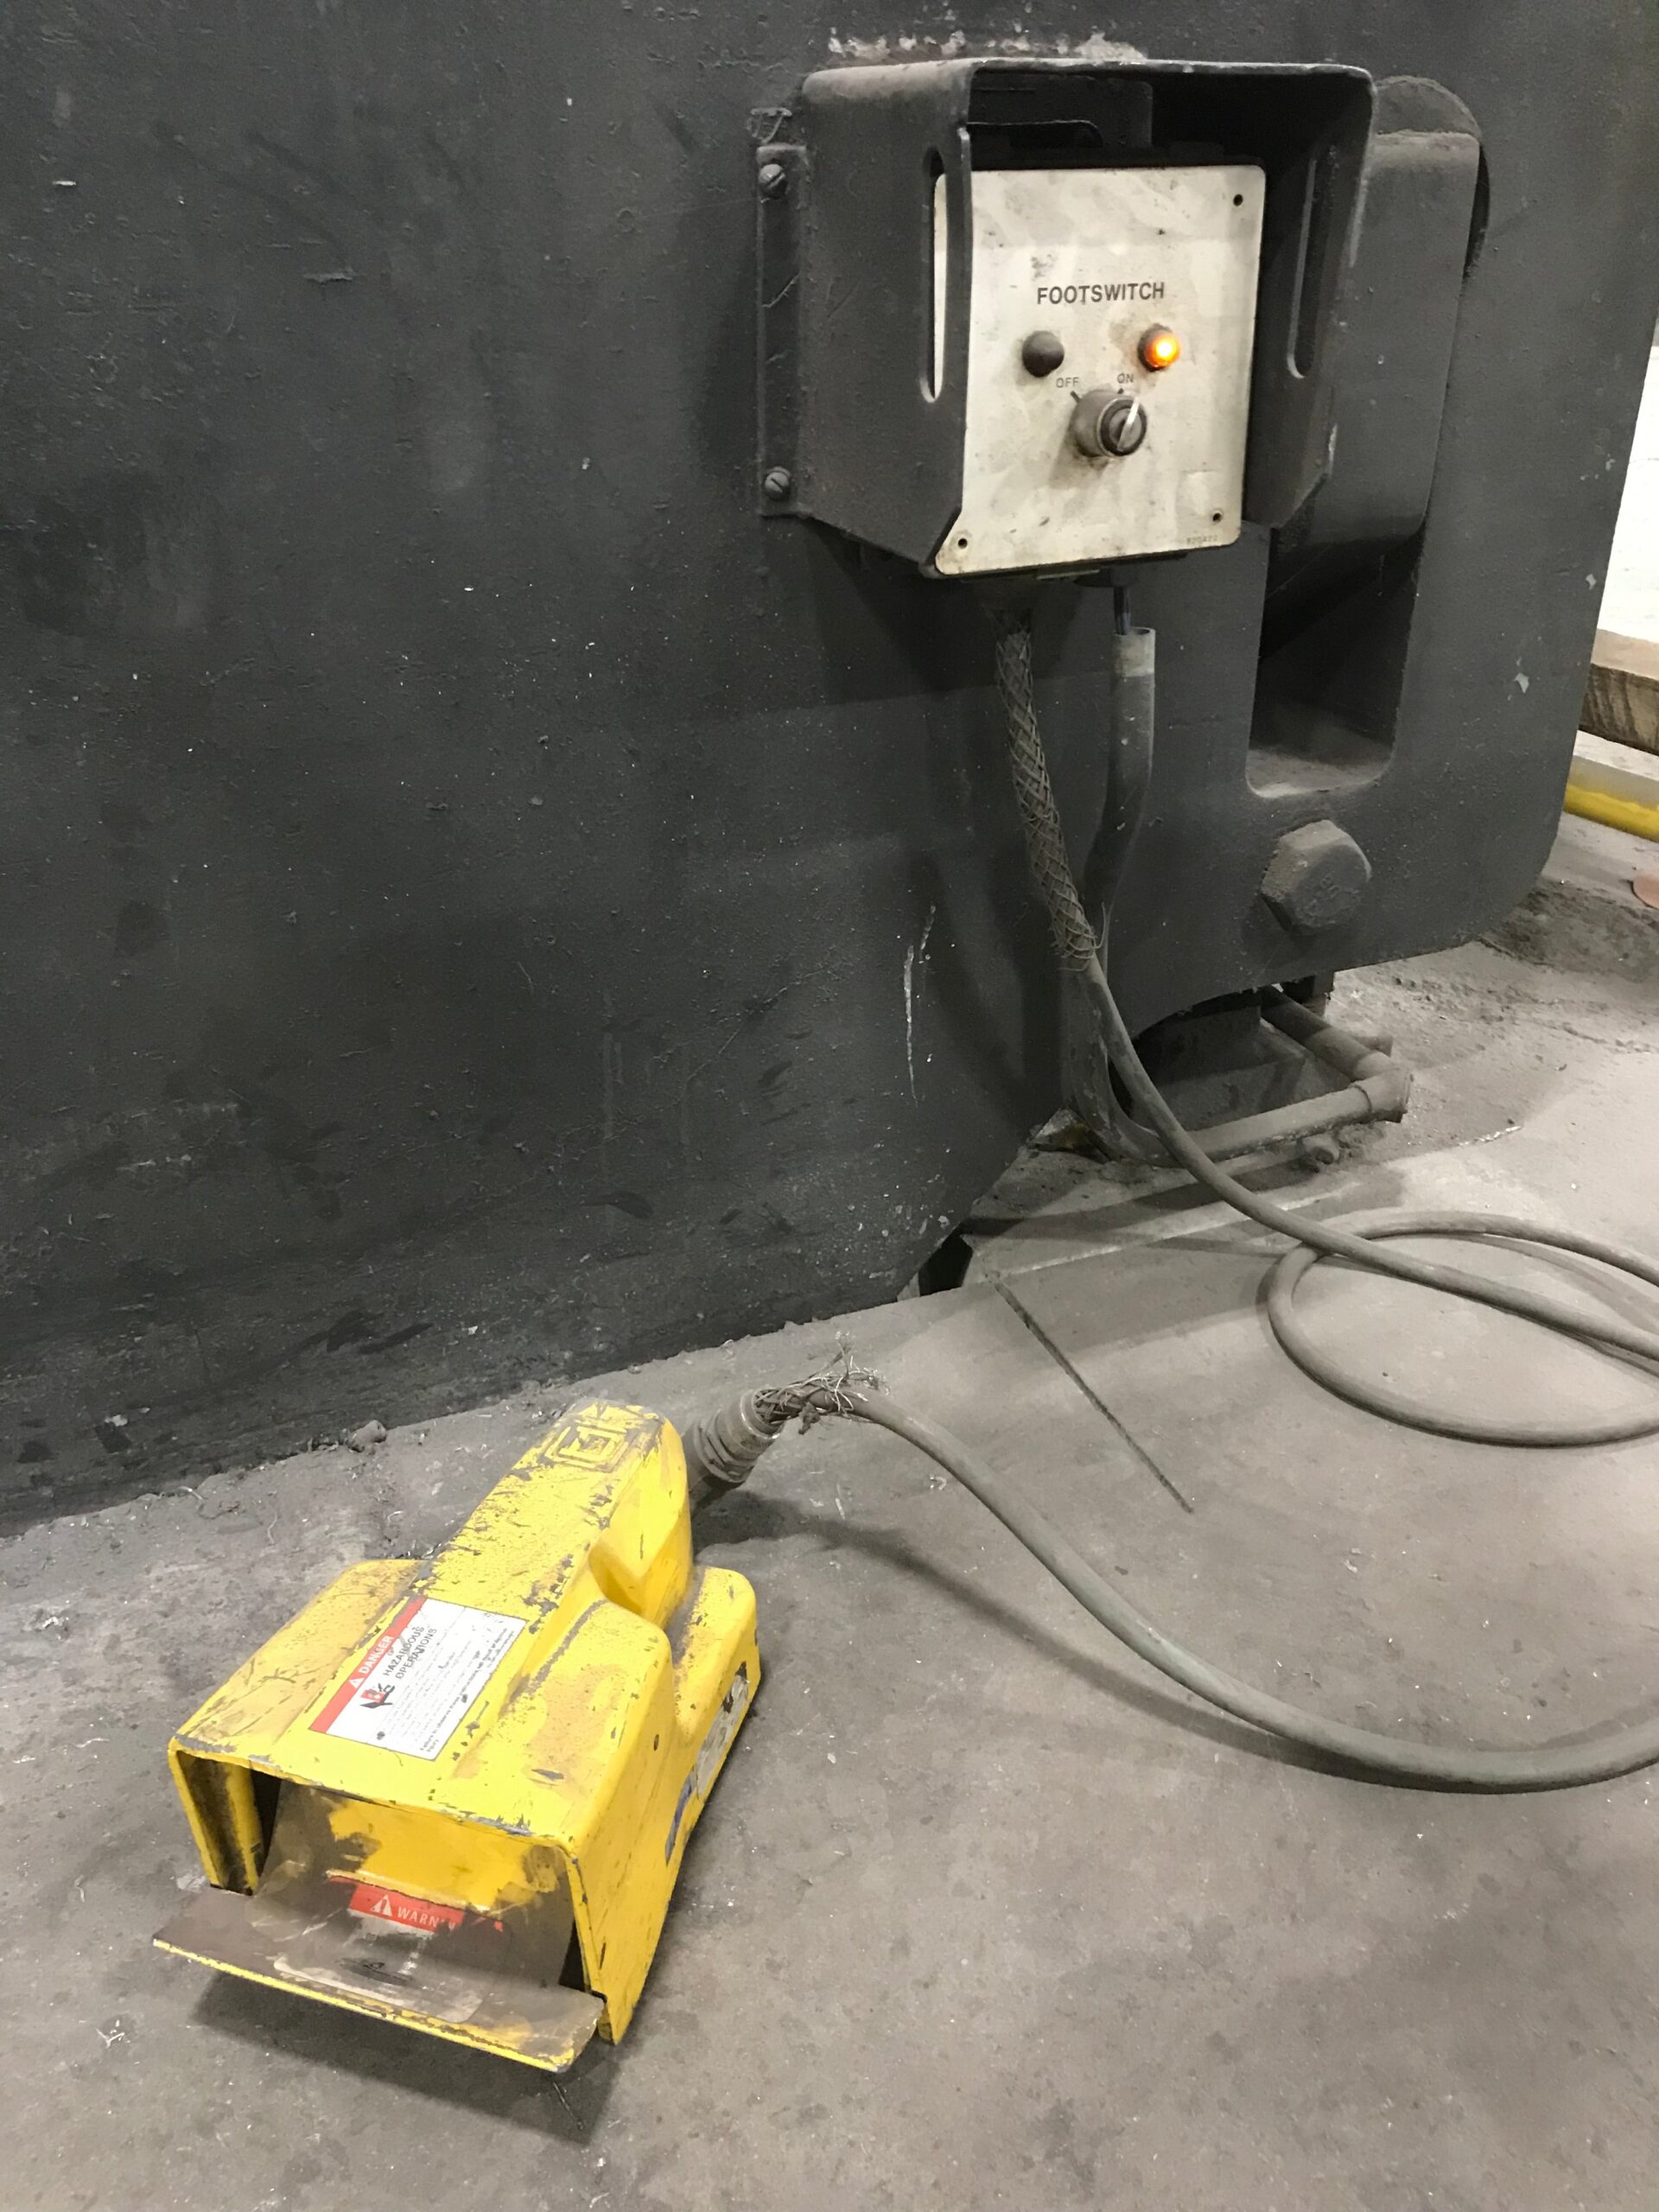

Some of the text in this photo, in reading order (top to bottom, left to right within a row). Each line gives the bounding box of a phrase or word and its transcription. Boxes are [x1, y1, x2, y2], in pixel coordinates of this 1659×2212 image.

[1037, 282, 1165, 304] FOOTSWITCH
[1056, 372, 1135, 388] OFF ON
[358, 1635, 395, 1675] DANGER
[382, 1626, 425, 1675] HAZARDOUS
[395, 1628, 437, 1680] OPERATIONS
